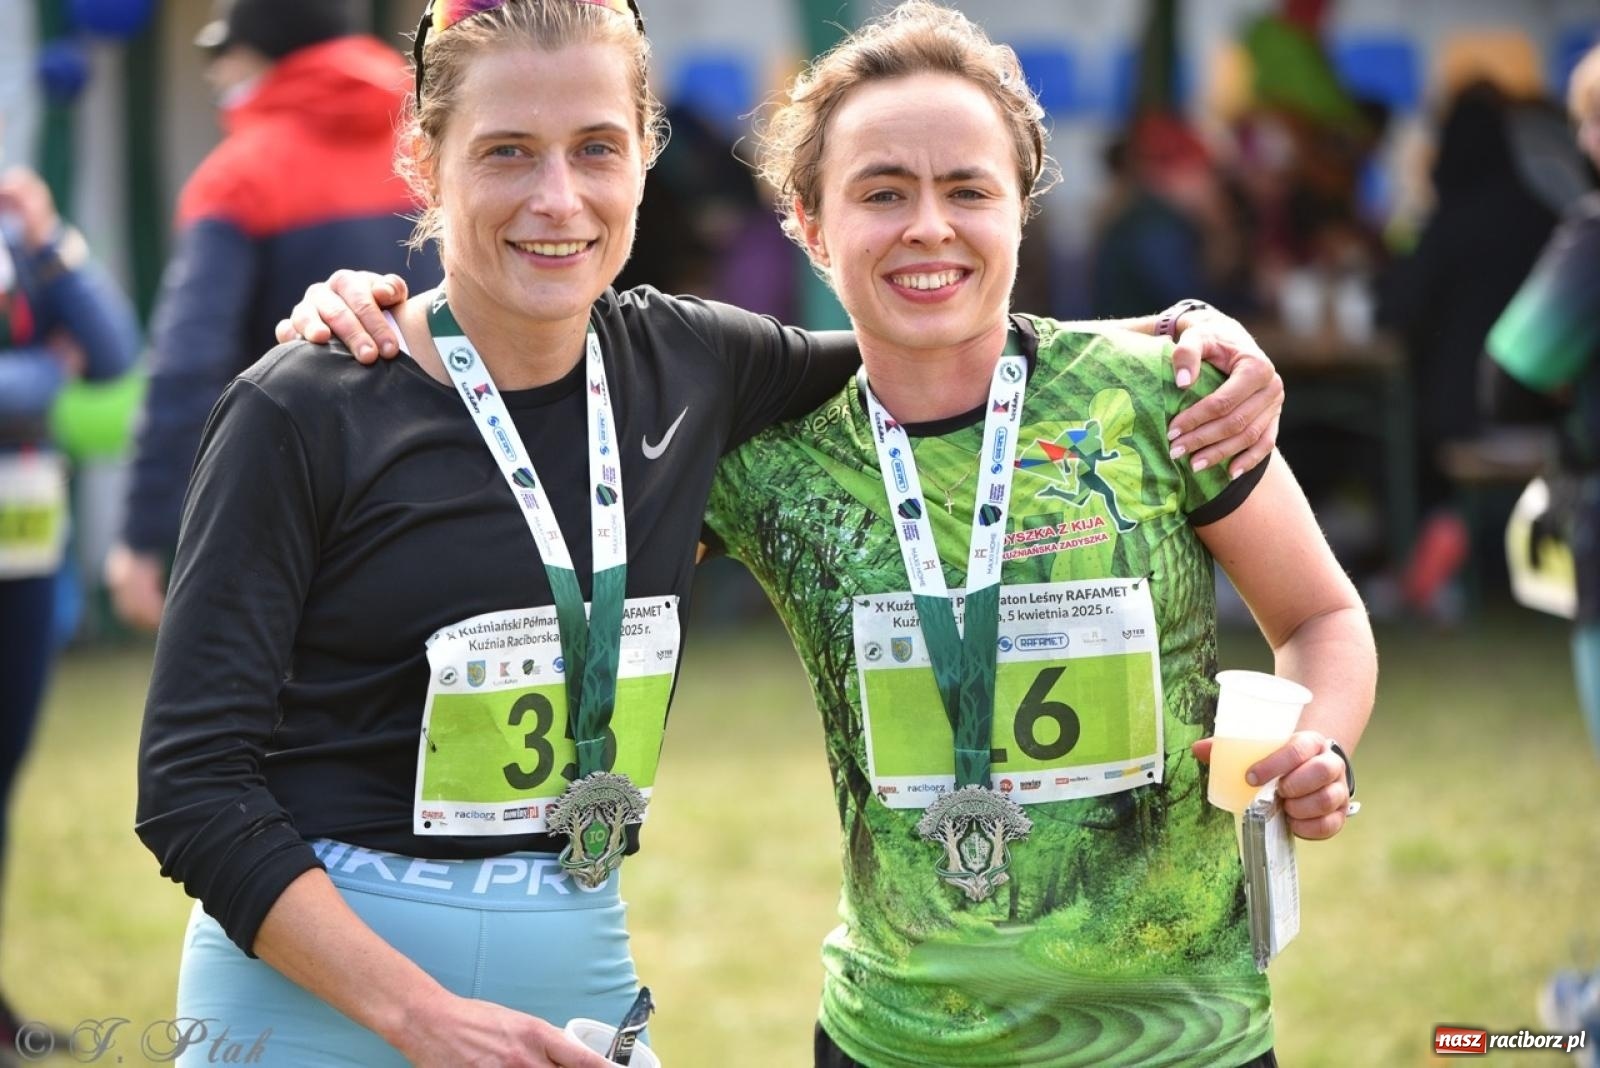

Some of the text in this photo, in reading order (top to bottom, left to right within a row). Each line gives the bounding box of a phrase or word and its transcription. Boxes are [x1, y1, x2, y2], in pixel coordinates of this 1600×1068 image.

[1059, 523, 1068, 535] Z
[1071, 516, 1105, 531] KIJA
[1060, 533, 1109, 550] ZADYSZKA
[875, 602, 884, 613] X
[1029, 591, 1064, 604] Leśny
[1066, 586, 1128, 601] RAFAMET
[622, 605, 662, 619] AFAMET
[1008, 610, 1015, 621] 5
[1017, 607, 1069, 621] kwietnia
[1071, 604, 1103, 618] 2025
[1105, 605, 1114, 615] r.
[469, 636, 506, 651] Kuźnia
[620, 623, 643, 636] 2025
[644, 625, 651, 635] r.
[1020, 636, 1064, 648] RAFAMET
